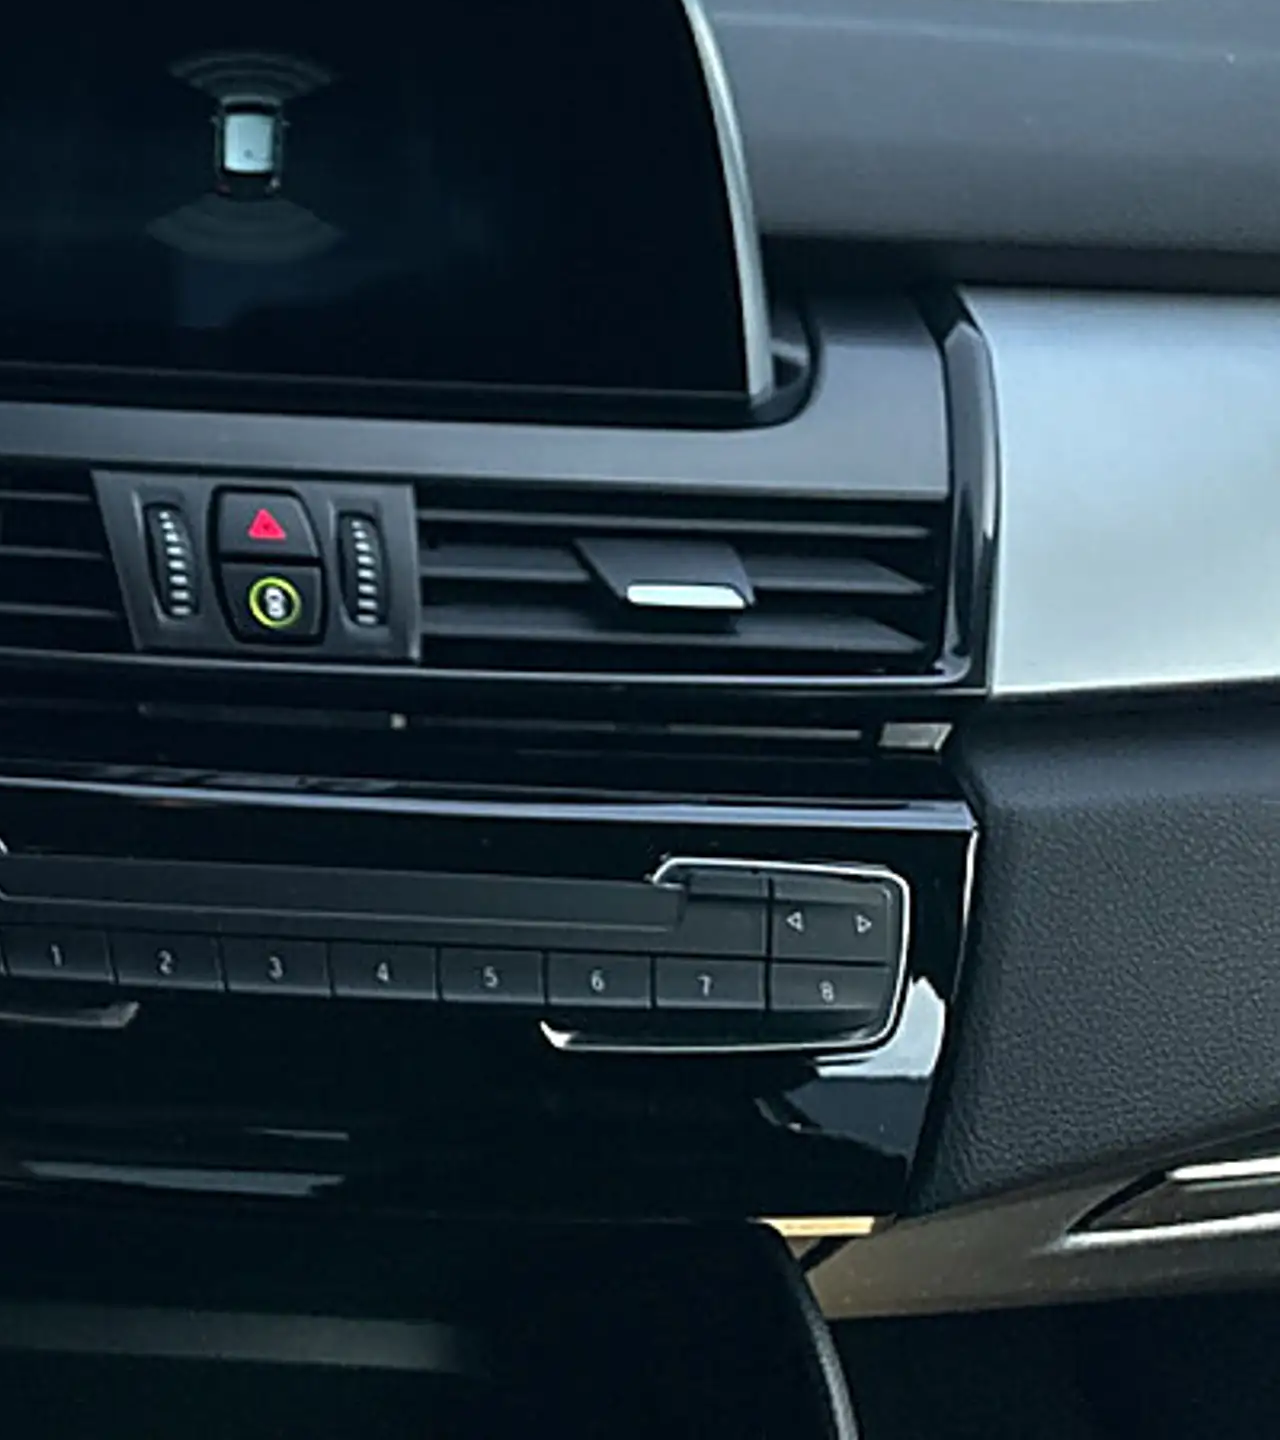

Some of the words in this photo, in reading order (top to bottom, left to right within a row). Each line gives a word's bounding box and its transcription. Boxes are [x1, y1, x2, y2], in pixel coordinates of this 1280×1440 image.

[51, 944, 63, 967] 1
[158, 950, 175, 975] 2
[268, 956, 283, 980] 3
[376, 961, 390, 984] 4
[483, 966, 498, 989] 5
[591, 969, 606, 992] 6
[698, 976, 713, 997] 7
